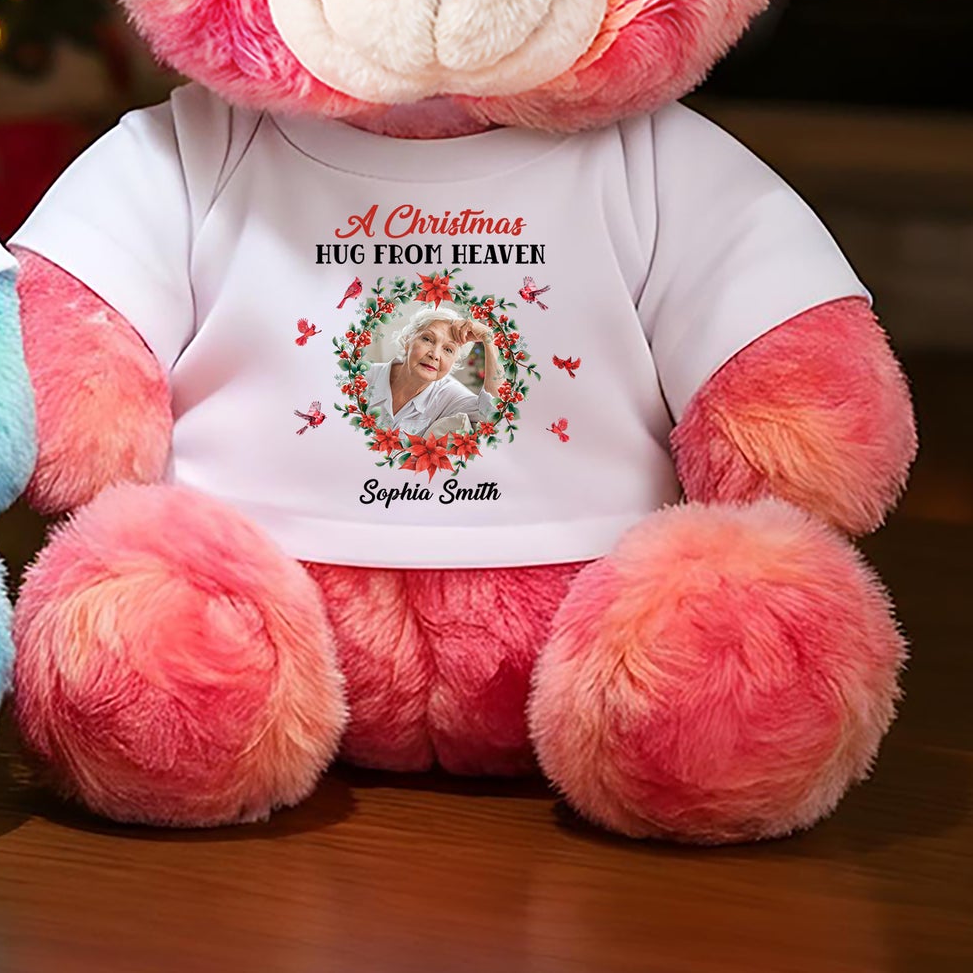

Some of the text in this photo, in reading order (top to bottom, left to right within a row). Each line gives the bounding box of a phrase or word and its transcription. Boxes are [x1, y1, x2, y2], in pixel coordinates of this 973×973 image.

[334, 204, 527, 239] A Christmas
[315, 243, 546, 265] HUG FROM HEAVEN
[359, 478, 502, 509] Sophia Smith
